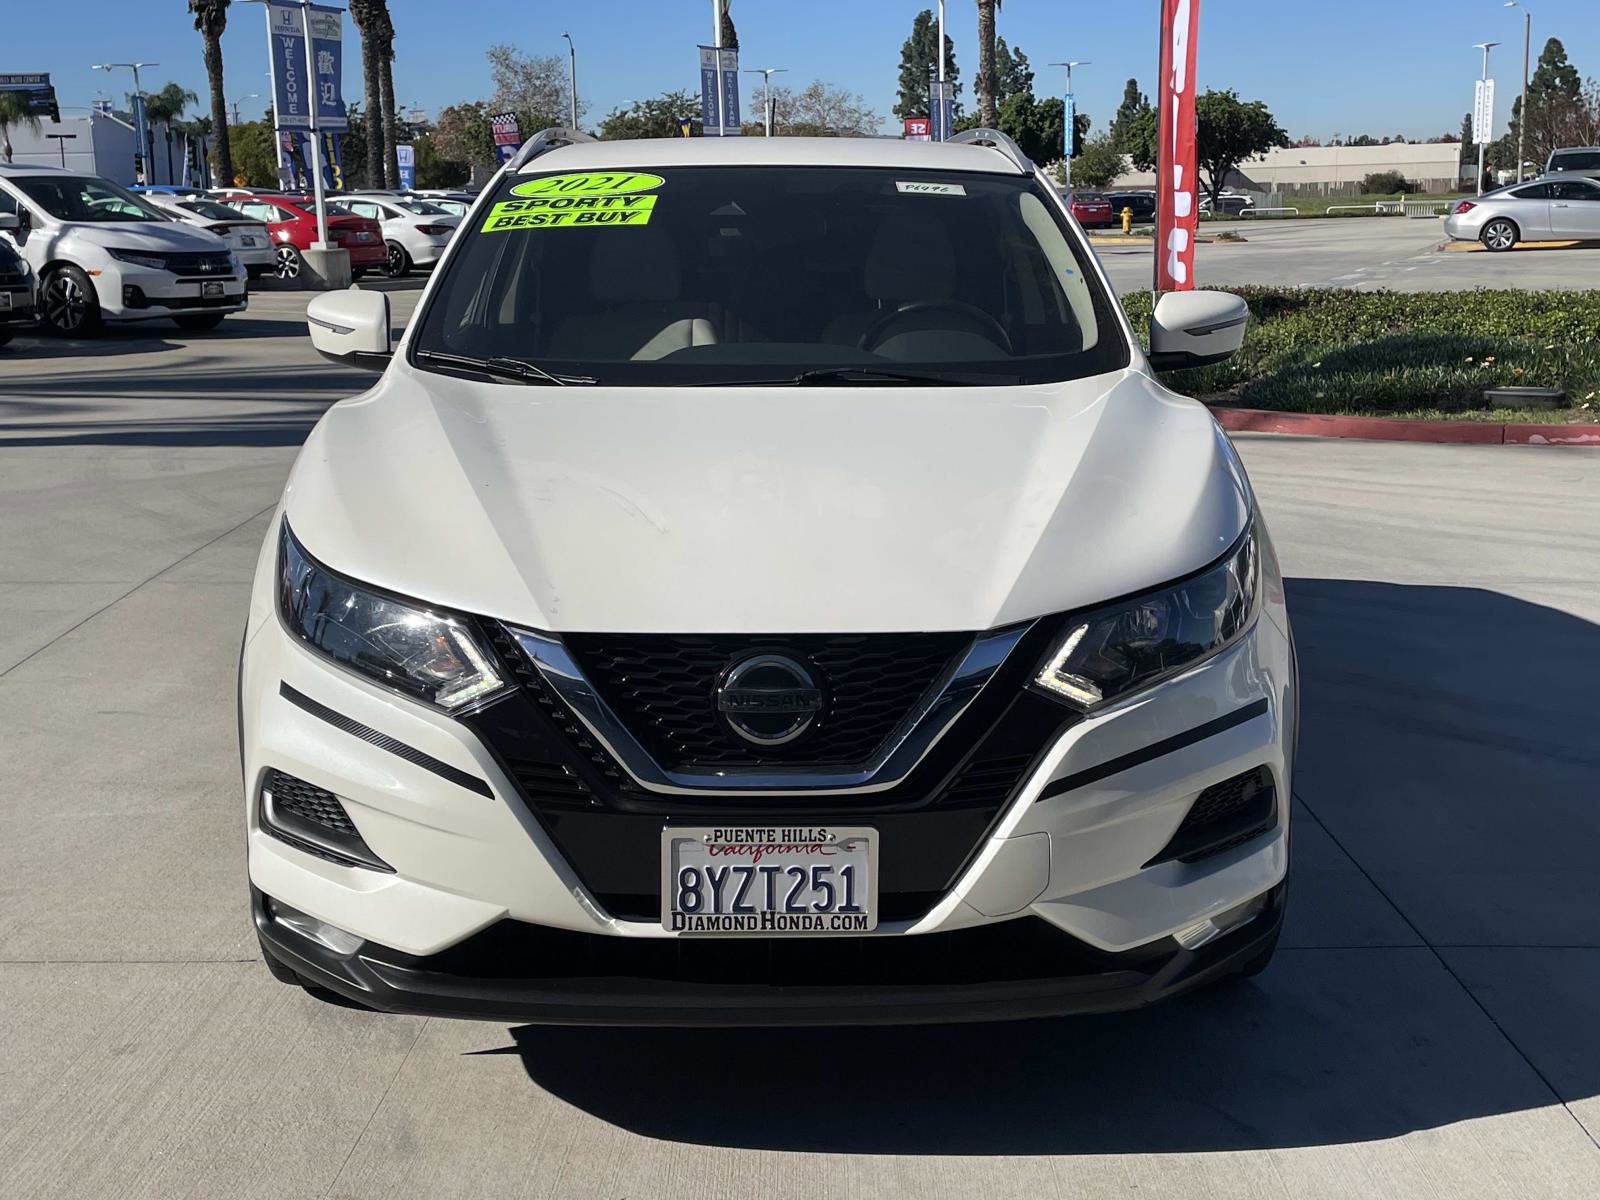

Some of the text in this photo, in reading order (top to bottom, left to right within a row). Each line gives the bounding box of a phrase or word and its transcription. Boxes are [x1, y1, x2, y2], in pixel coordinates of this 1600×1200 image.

[274, 25, 300, 33] HONDA
[280, 36, 298, 114] WELCOME
[704, 71, 715, 125] WELCOME
[531, 175, 636, 194] 2021
[500, 195, 644, 213] SPORTY
[493, 211, 641, 229] BEST BUY
[728, 694, 810, 708] NISSAN
[713, 829, 827, 843] PUENTE HILLS
[679, 866, 860, 912] 8YZT251
